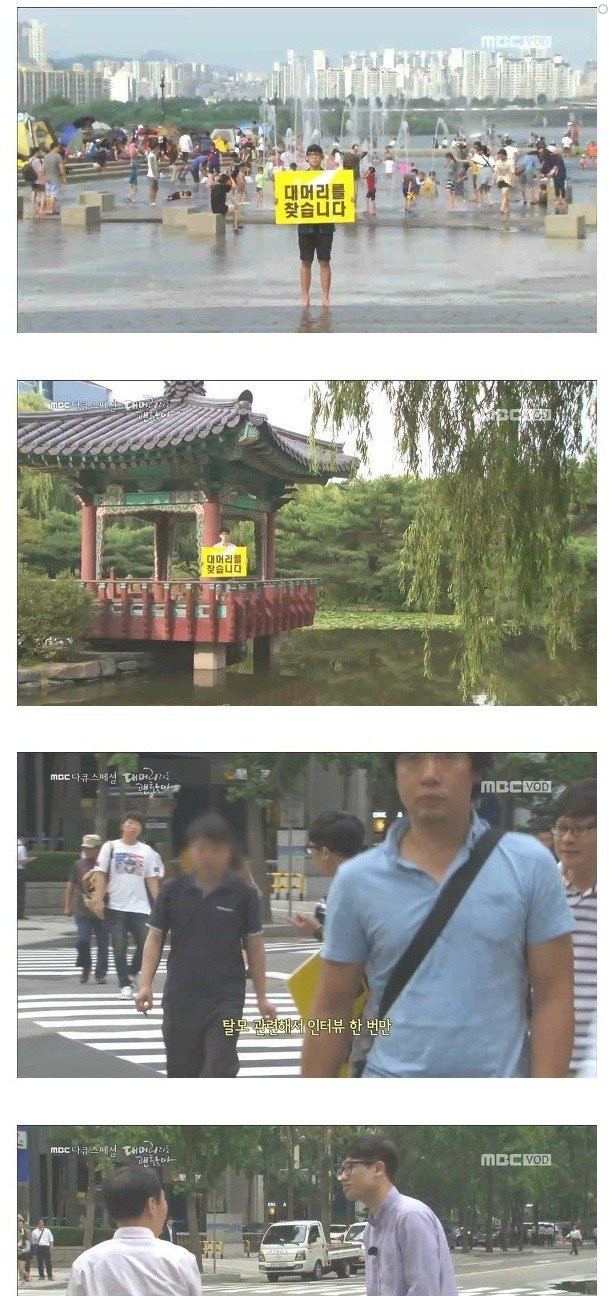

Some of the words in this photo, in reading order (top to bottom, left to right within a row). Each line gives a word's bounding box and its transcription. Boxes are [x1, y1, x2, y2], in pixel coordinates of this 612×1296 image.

[284, 184, 345, 200] 대머리를
[284, 201, 346, 218] 찾습니다
[206, 554, 242, 564] 대머리를
[206, 565, 242, 574] 찾습니다
